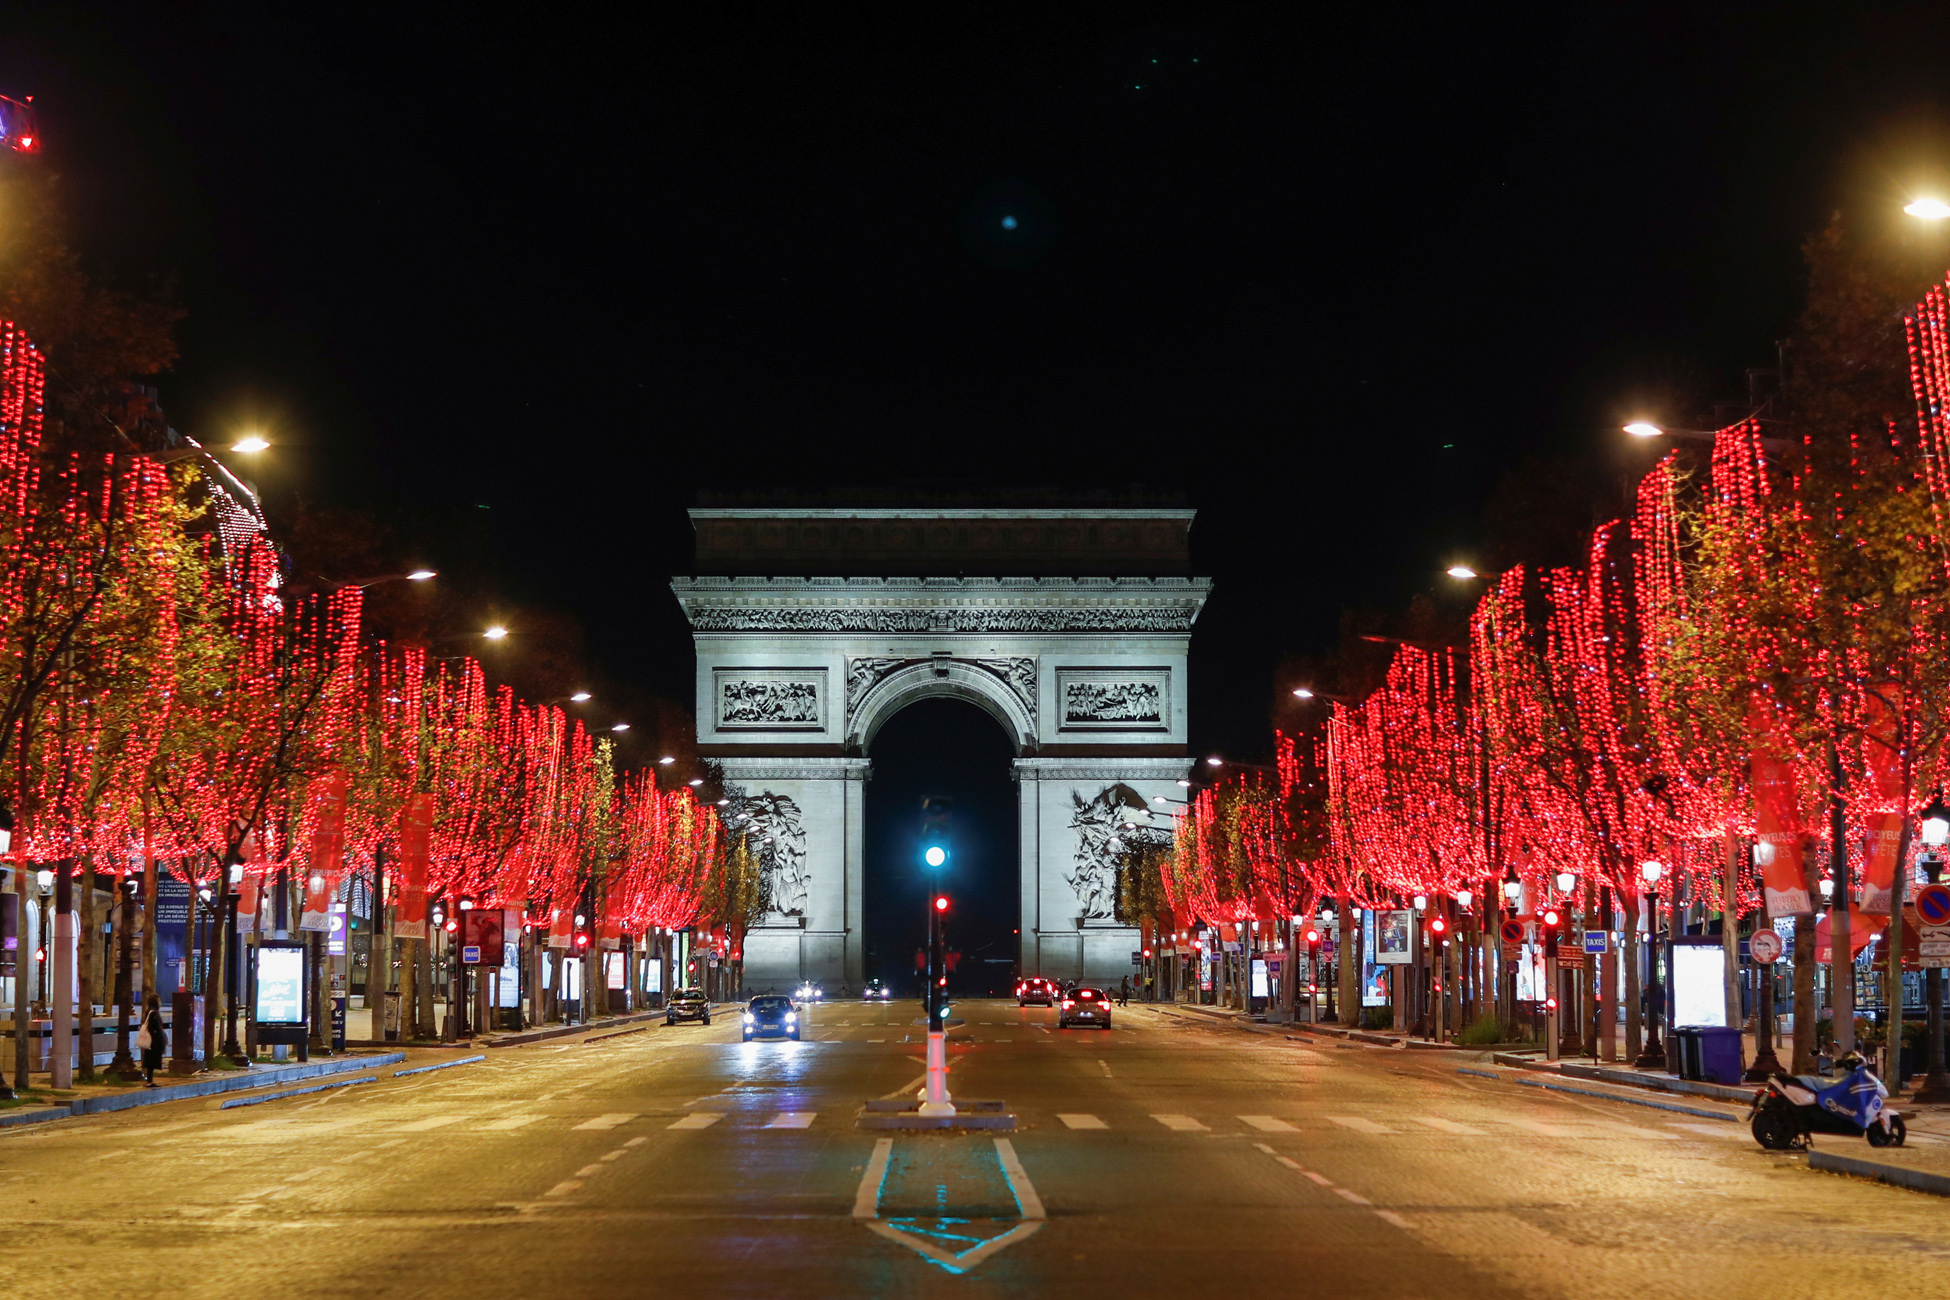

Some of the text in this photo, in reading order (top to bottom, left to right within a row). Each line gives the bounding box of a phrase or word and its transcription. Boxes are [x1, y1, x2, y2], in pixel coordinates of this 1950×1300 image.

[1865, 829, 1902, 841] JOYEUS
[1876, 842, 1898, 857] FÊTE
[1586, 938, 1605, 946] TAXIS
